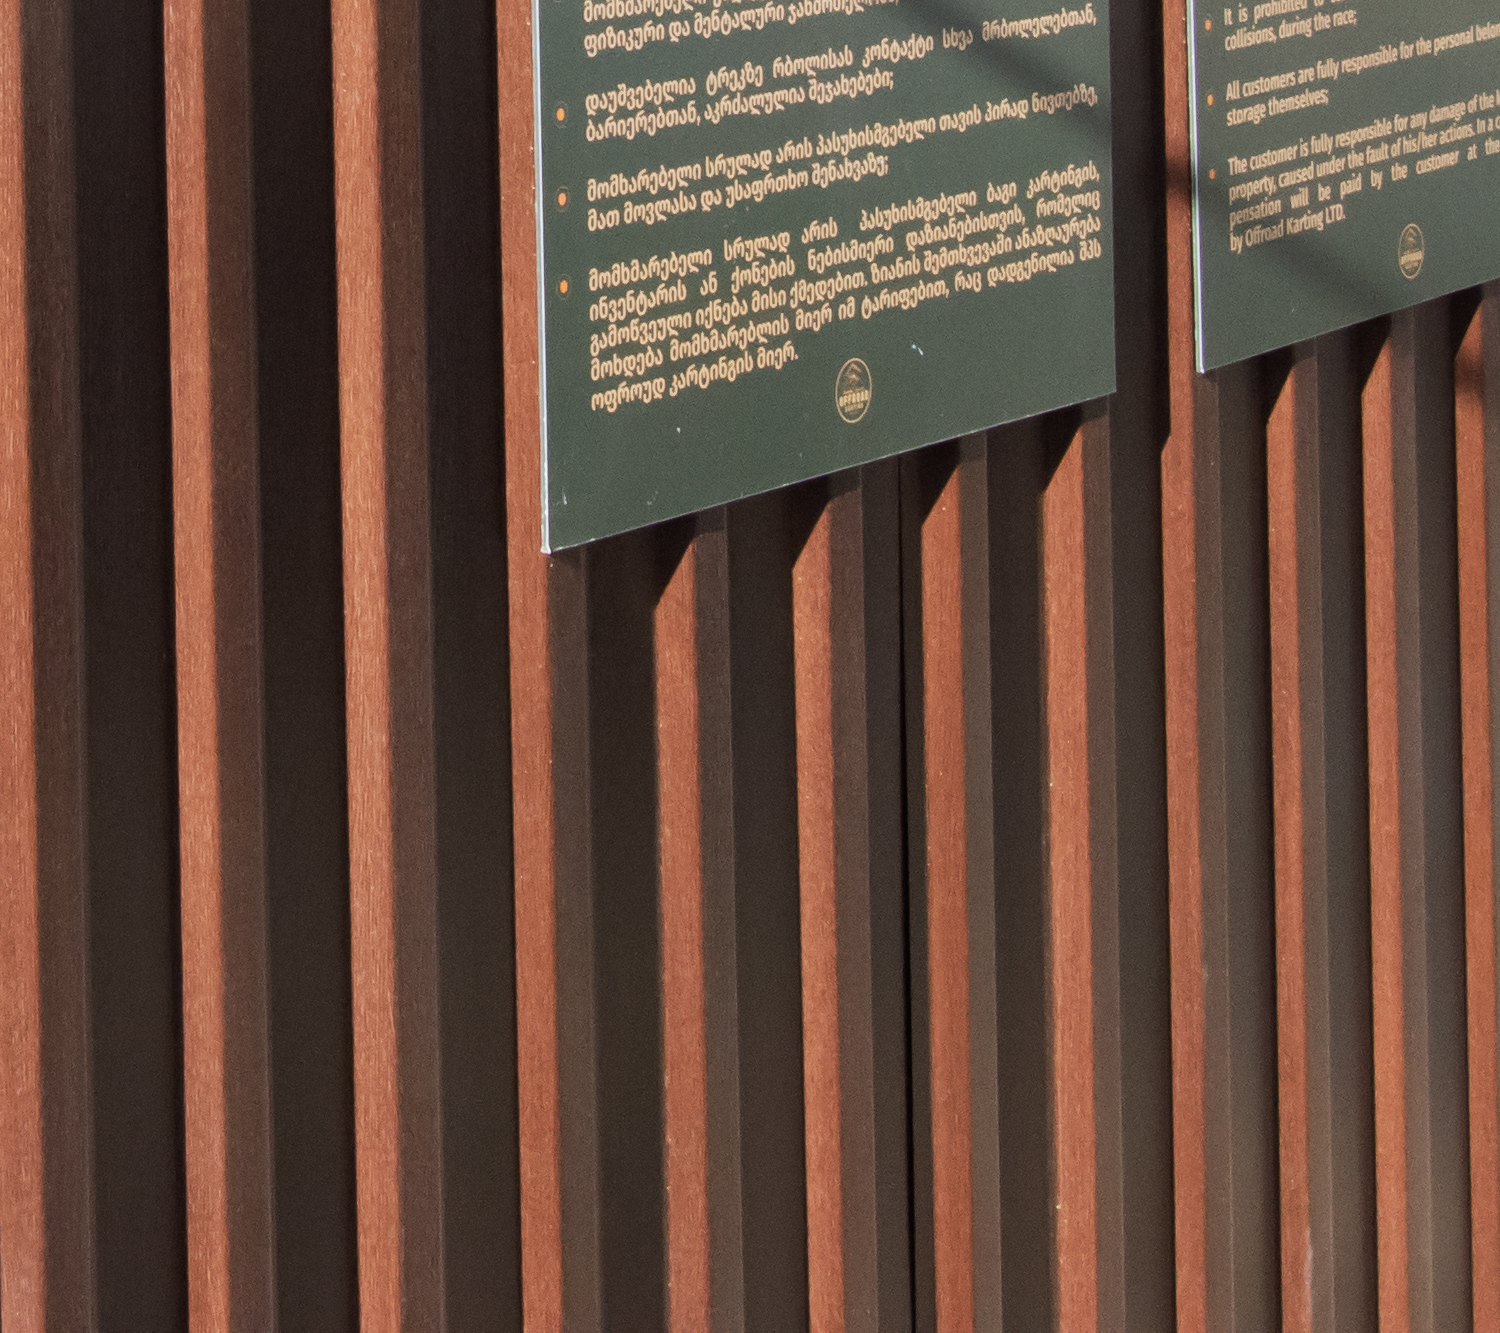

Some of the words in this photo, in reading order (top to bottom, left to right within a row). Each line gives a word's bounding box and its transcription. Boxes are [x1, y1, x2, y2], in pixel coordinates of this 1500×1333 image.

[1223, 7, 1233, 26] It
[1237, 2, 1249, 23] is
[1277, 14, 1313, 39] during
[1312, 11, 1332, 32] the
[1225, 79, 1241, 101] All
[1241, 70, 1296, 98] customers
[1296, 66, 1315, 84] are
[1340, 43, 1399, 75] responsible
[1398, 40, 1415, 60] for
[1414, 36, 1432, 56] the
[1432, 24, 1475, 56] personal
[1225, 102, 1267, 127] storage
[586, 207, 620, 232] მათ
[699, 188, 723, 212] და
[1229, 228, 1244, 255] by
[1244, 218, 1284, 247] Offroad
[1285, 208, 1324, 235] Karting
